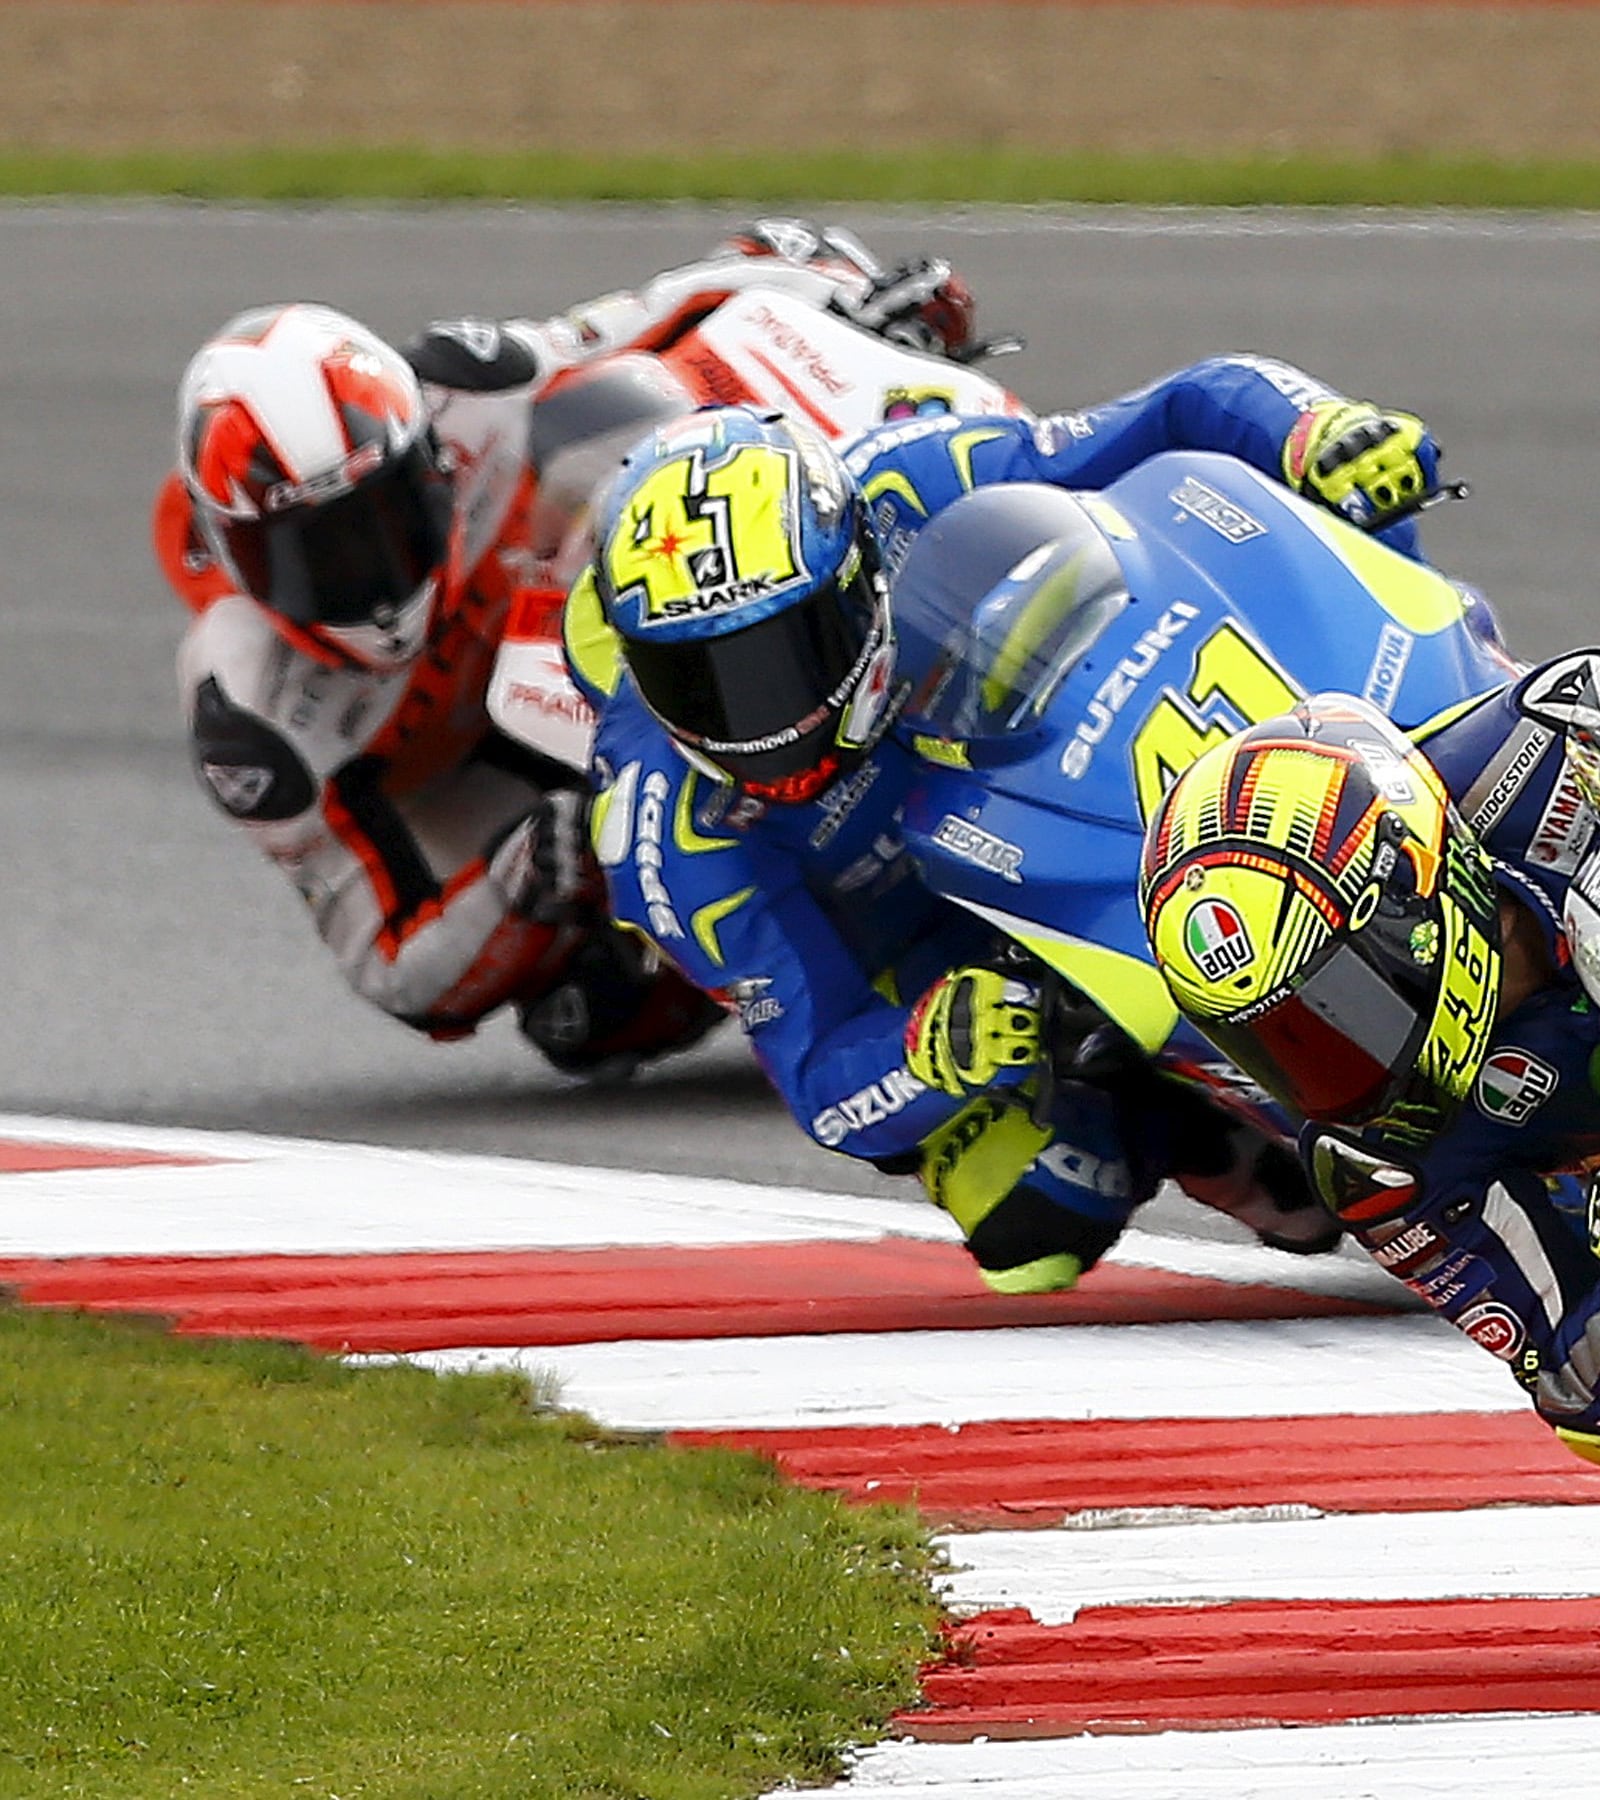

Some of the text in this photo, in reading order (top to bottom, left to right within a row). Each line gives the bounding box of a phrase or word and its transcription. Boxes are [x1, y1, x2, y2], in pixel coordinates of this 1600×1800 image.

[610, 445, 800, 620] 41
[664, 573, 777, 616] SHARK
[1060, 600, 1200, 779] SUZUKI
[1369, 625, 1407, 706] MOTUL
[1200, 935, 1256, 981] agv
[812, 1069, 926, 1146] SUZUK
[1504, 1064, 1552, 1118] agv
